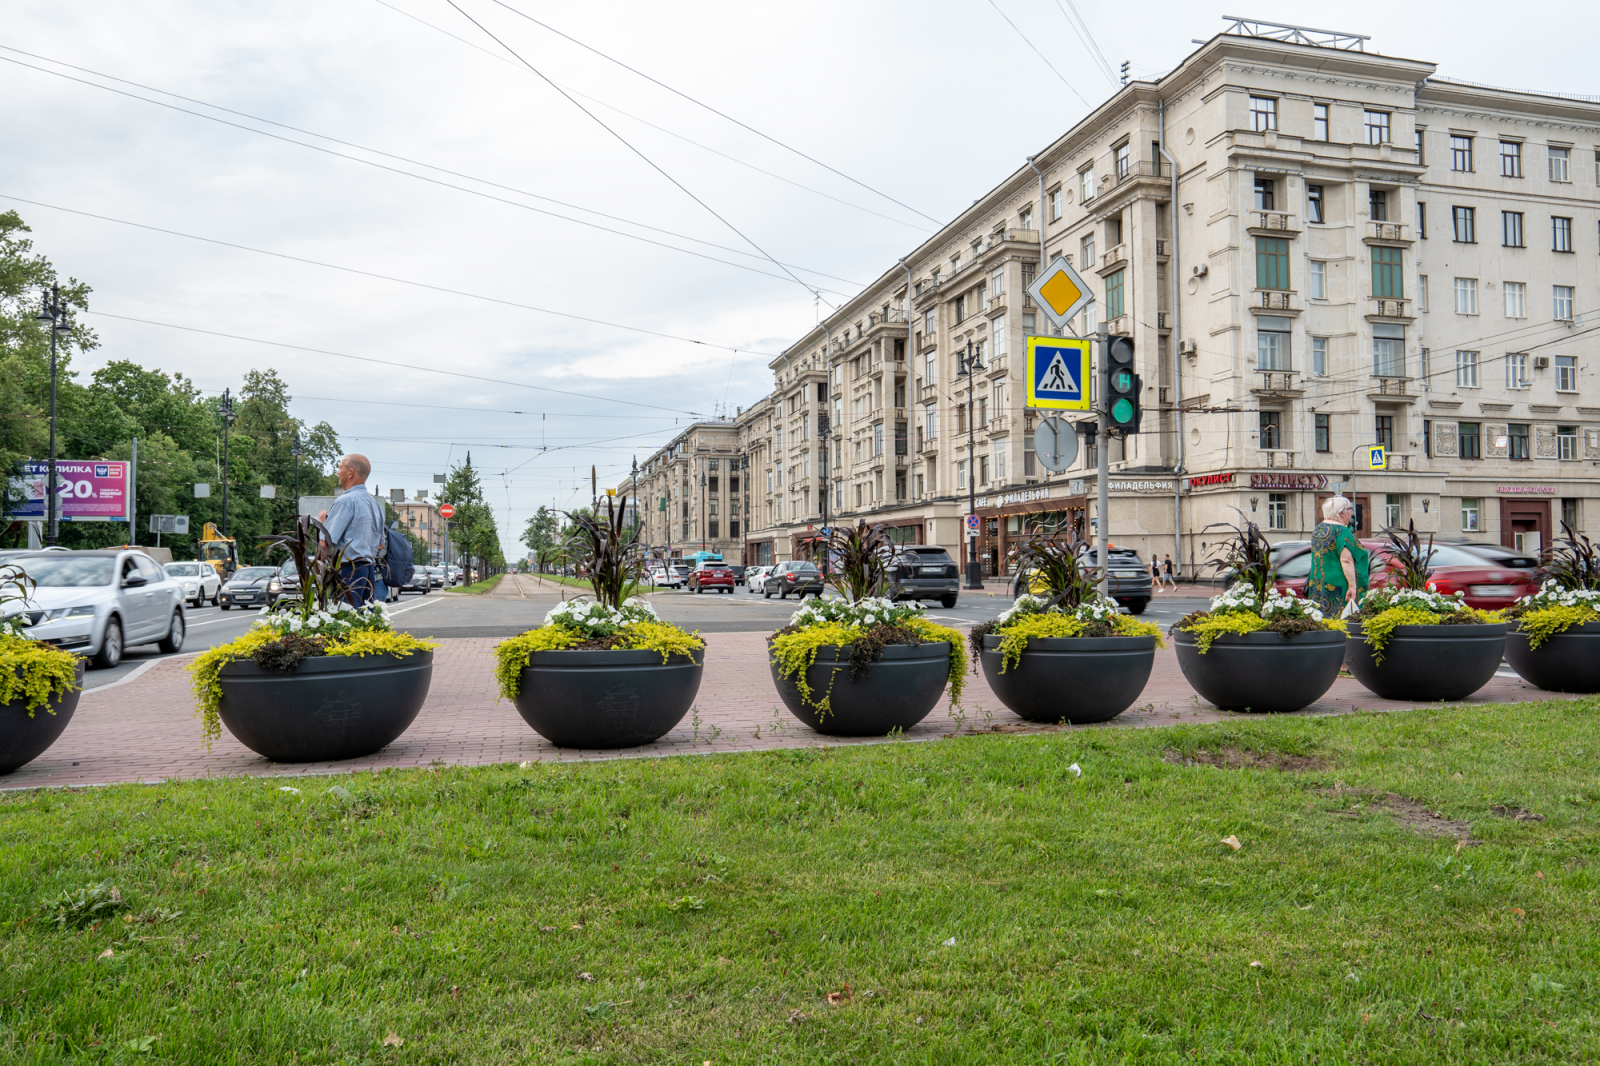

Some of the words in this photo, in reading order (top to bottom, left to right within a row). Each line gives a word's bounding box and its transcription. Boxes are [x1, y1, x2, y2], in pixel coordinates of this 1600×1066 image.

[39, 465, 92, 473] КПИЛКА
[1189, 473, 1232, 486] ОКУЛИСТ
[1251, 473, 1316, 484] ОКУЛИСТ
[1108, 481, 1173, 491] ФИЛАДЕЛЬФИЯ
[1005, 488, 1050, 504] ФИЛАДЕЛЬФИЯ
